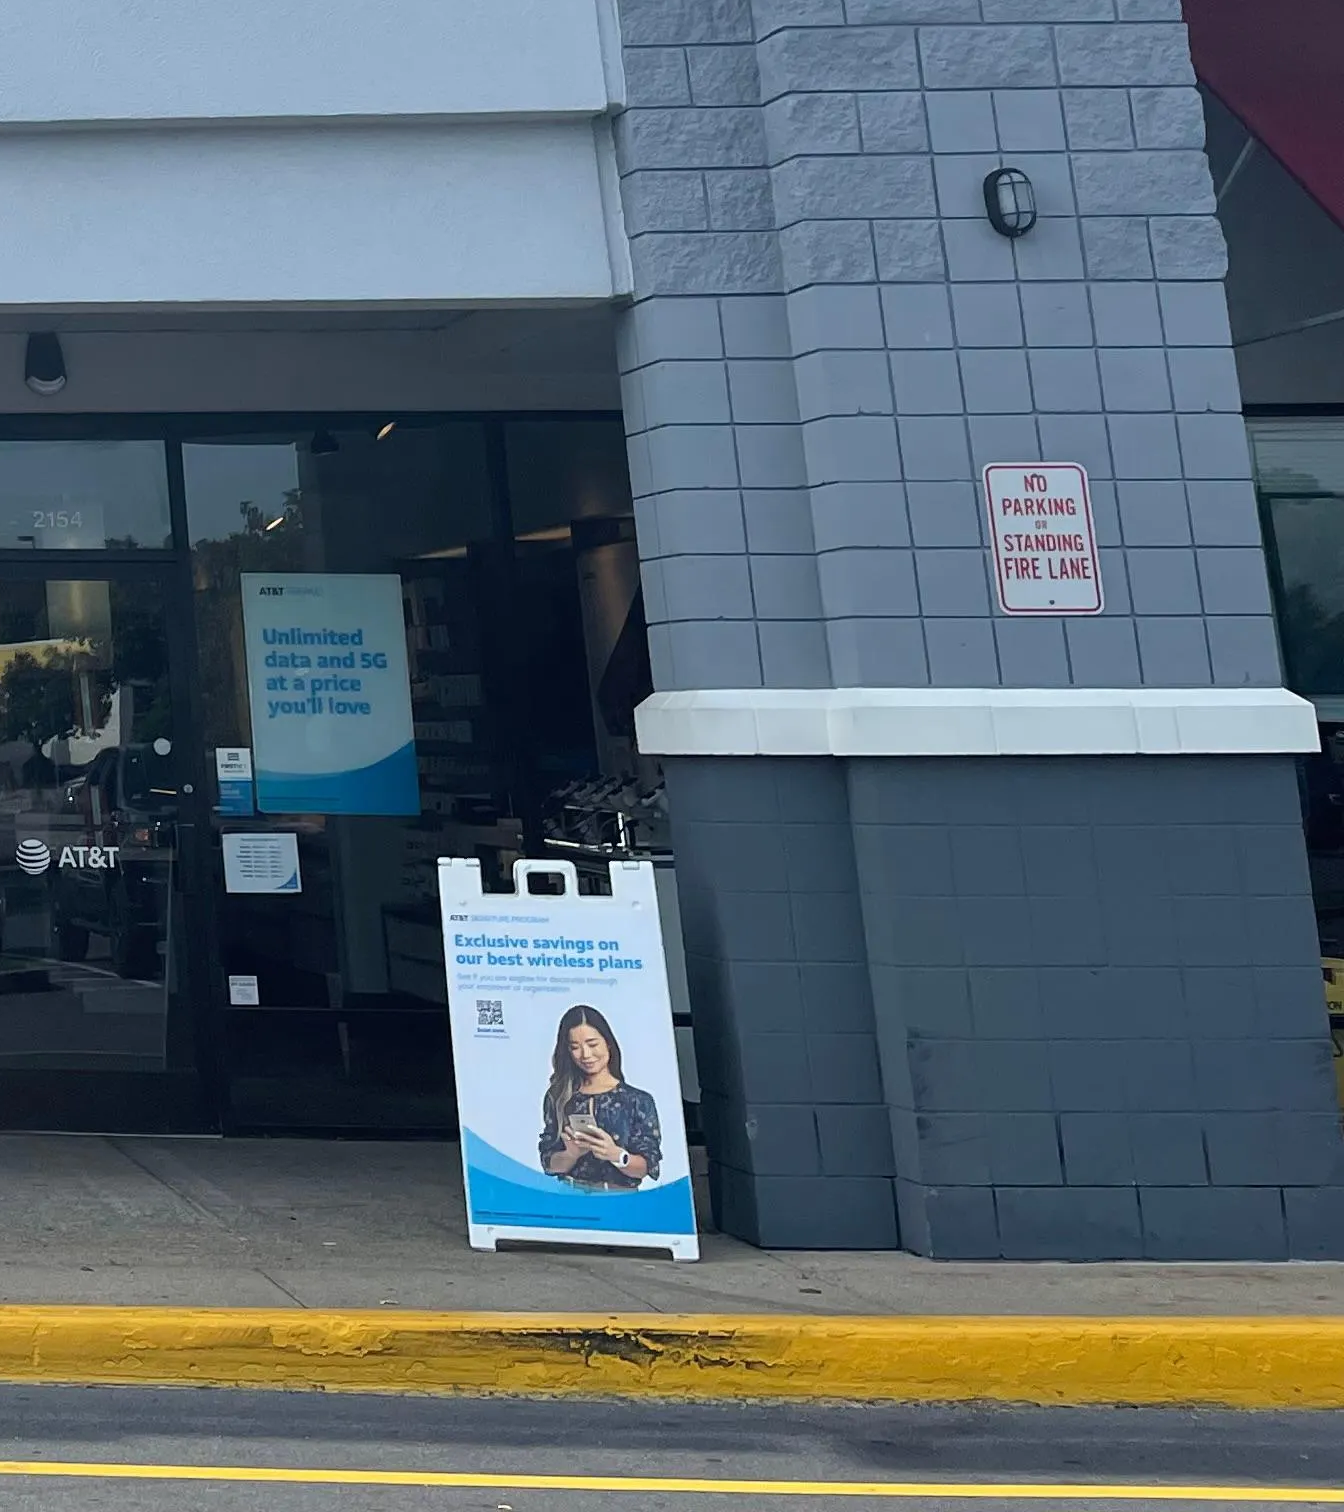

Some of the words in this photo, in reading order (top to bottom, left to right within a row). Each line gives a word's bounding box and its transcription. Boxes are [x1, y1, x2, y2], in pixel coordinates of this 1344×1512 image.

[1024, 473, 1047, 492] NO
[1002, 498, 1076, 516] PARKING
[33, 510, 83, 528] 2154
[1035, 520, 1048, 529] OR
[1004, 534, 1085, 552] STANDING
[1004, 557, 1042, 580] FIRE
[1048, 557, 1092, 580] LANE
[259, 587, 284, 596] AT&T
[262, 628, 364, 645] Unlimited
[265, 651, 311, 668] data
[317, 652, 355, 668] and
[360, 652, 388, 669] 5G
[266, 675, 288, 691] at
[293, 678, 305, 691] a
[311, 674, 362, 696] price
[268, 697, 323, 719] you'll
[329, 697, 372, 715] love
[58, 846, 120, 868] AT&T
[454, 934, 529, 949] Exclusive
[533, 936, 594, 953] savings
[598, 939, 619, 951] on
[456, 954, 483, 965] our
[487, 952, 522, 966] best
[527, 953, 594, 968] wireless
[598, 955, 642, 971] plans
